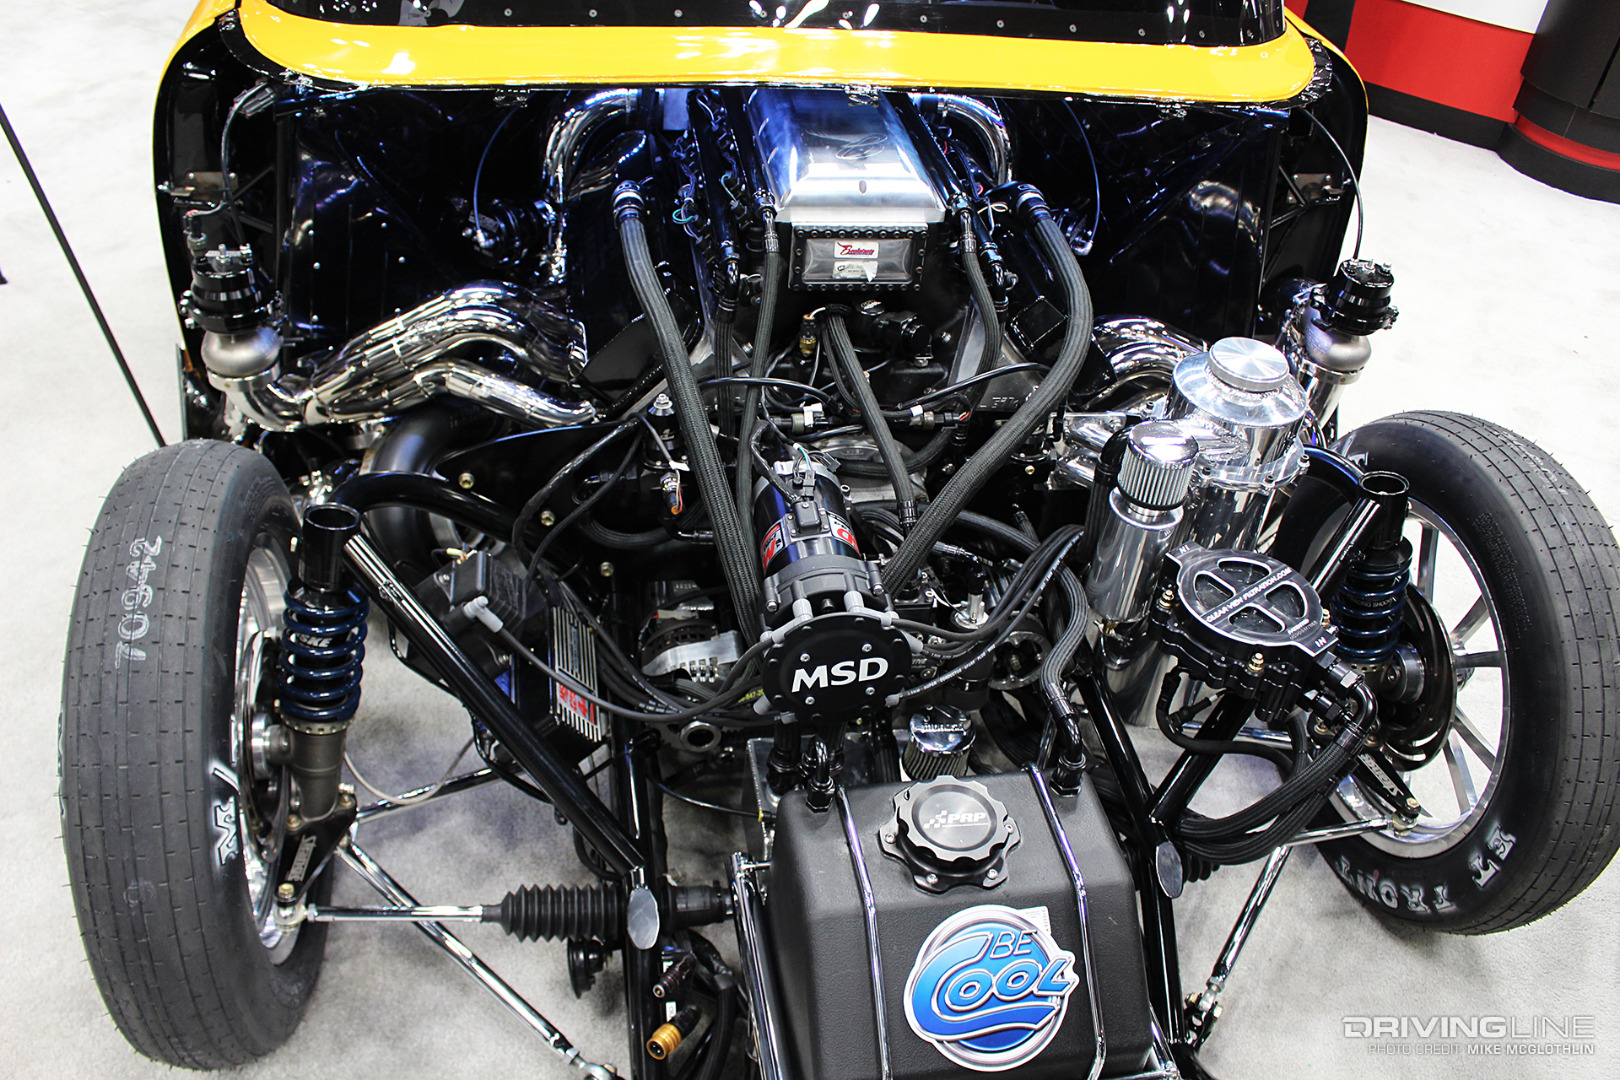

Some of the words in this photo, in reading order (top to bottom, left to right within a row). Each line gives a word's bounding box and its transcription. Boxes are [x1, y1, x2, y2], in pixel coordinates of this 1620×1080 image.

[1206, 606, 1227, 623] CLEAR
[1243, 567, 1293, 600] FILTRATION.COM
[1314, 636, 1328, 648] IN
[791, 656, 889, 693] MSD
[947, 812, 987, 823] PRP
[1468, 822, 1517, 889] ET
[989, 930, 1037, 960] BE
[911, 931, 1077, 1041] COOL
